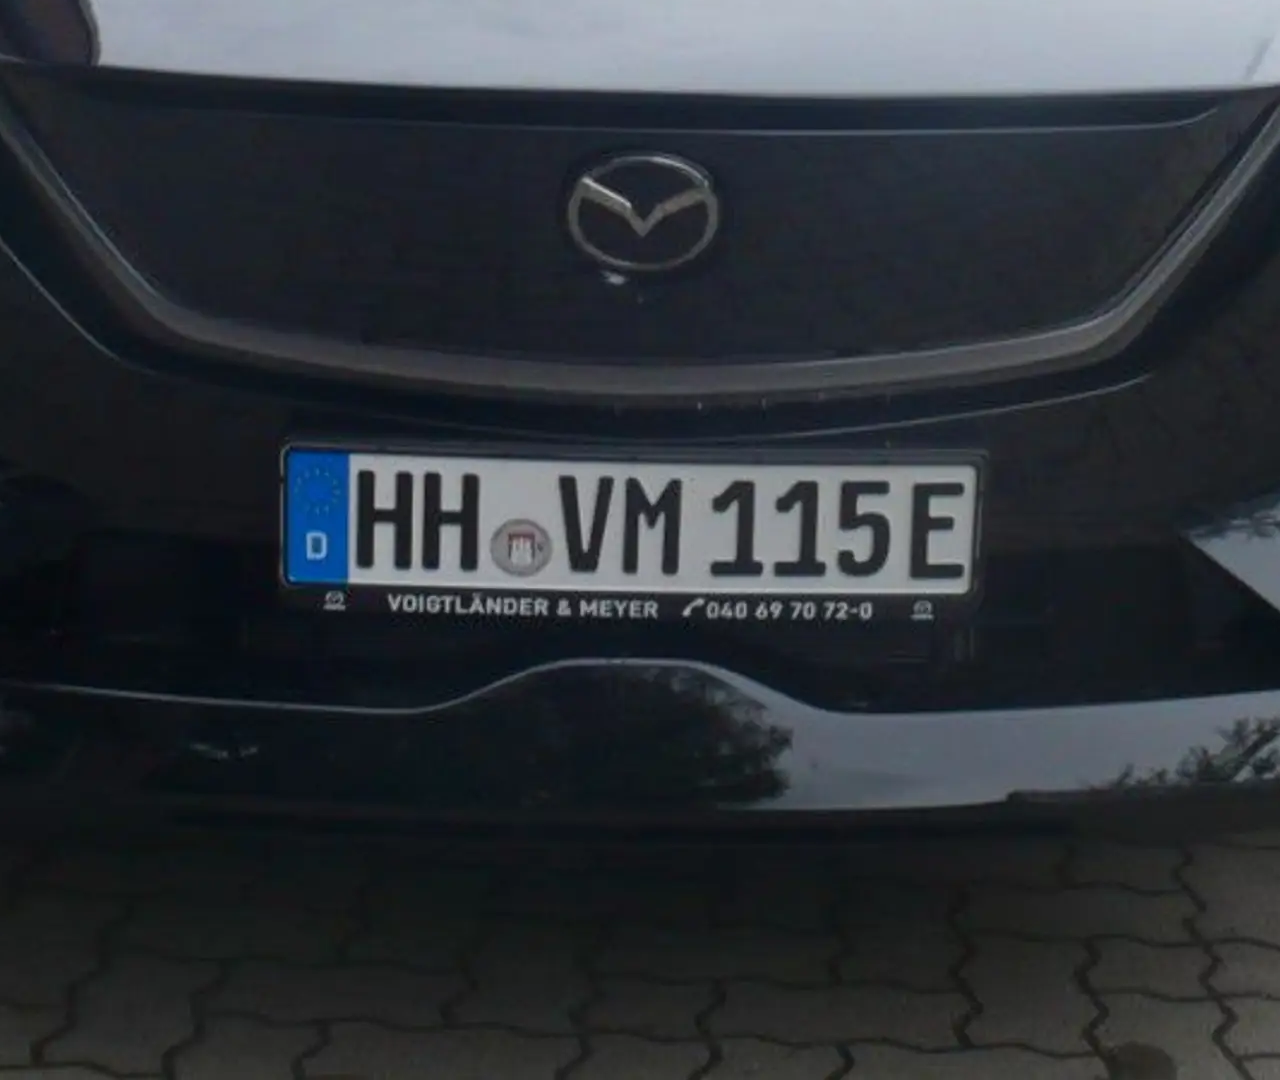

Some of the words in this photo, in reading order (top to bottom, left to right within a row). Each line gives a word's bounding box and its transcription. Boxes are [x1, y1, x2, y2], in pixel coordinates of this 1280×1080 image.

[356, 470, 480, 572] HH
[558, 475, 682, 576] VM
[306, 531, 326, 560] D
[387, 592, 549, 616] VOIGTLÄNDER
[556, 599, 572, 616] &
[579, 600, 659, 619] MEYER
[706, 600, 748, 619] 040
[754, 601, 784, 620] 69
[790, 601, 817, 620] 70
[824, 601, 873, 620] 72-0
